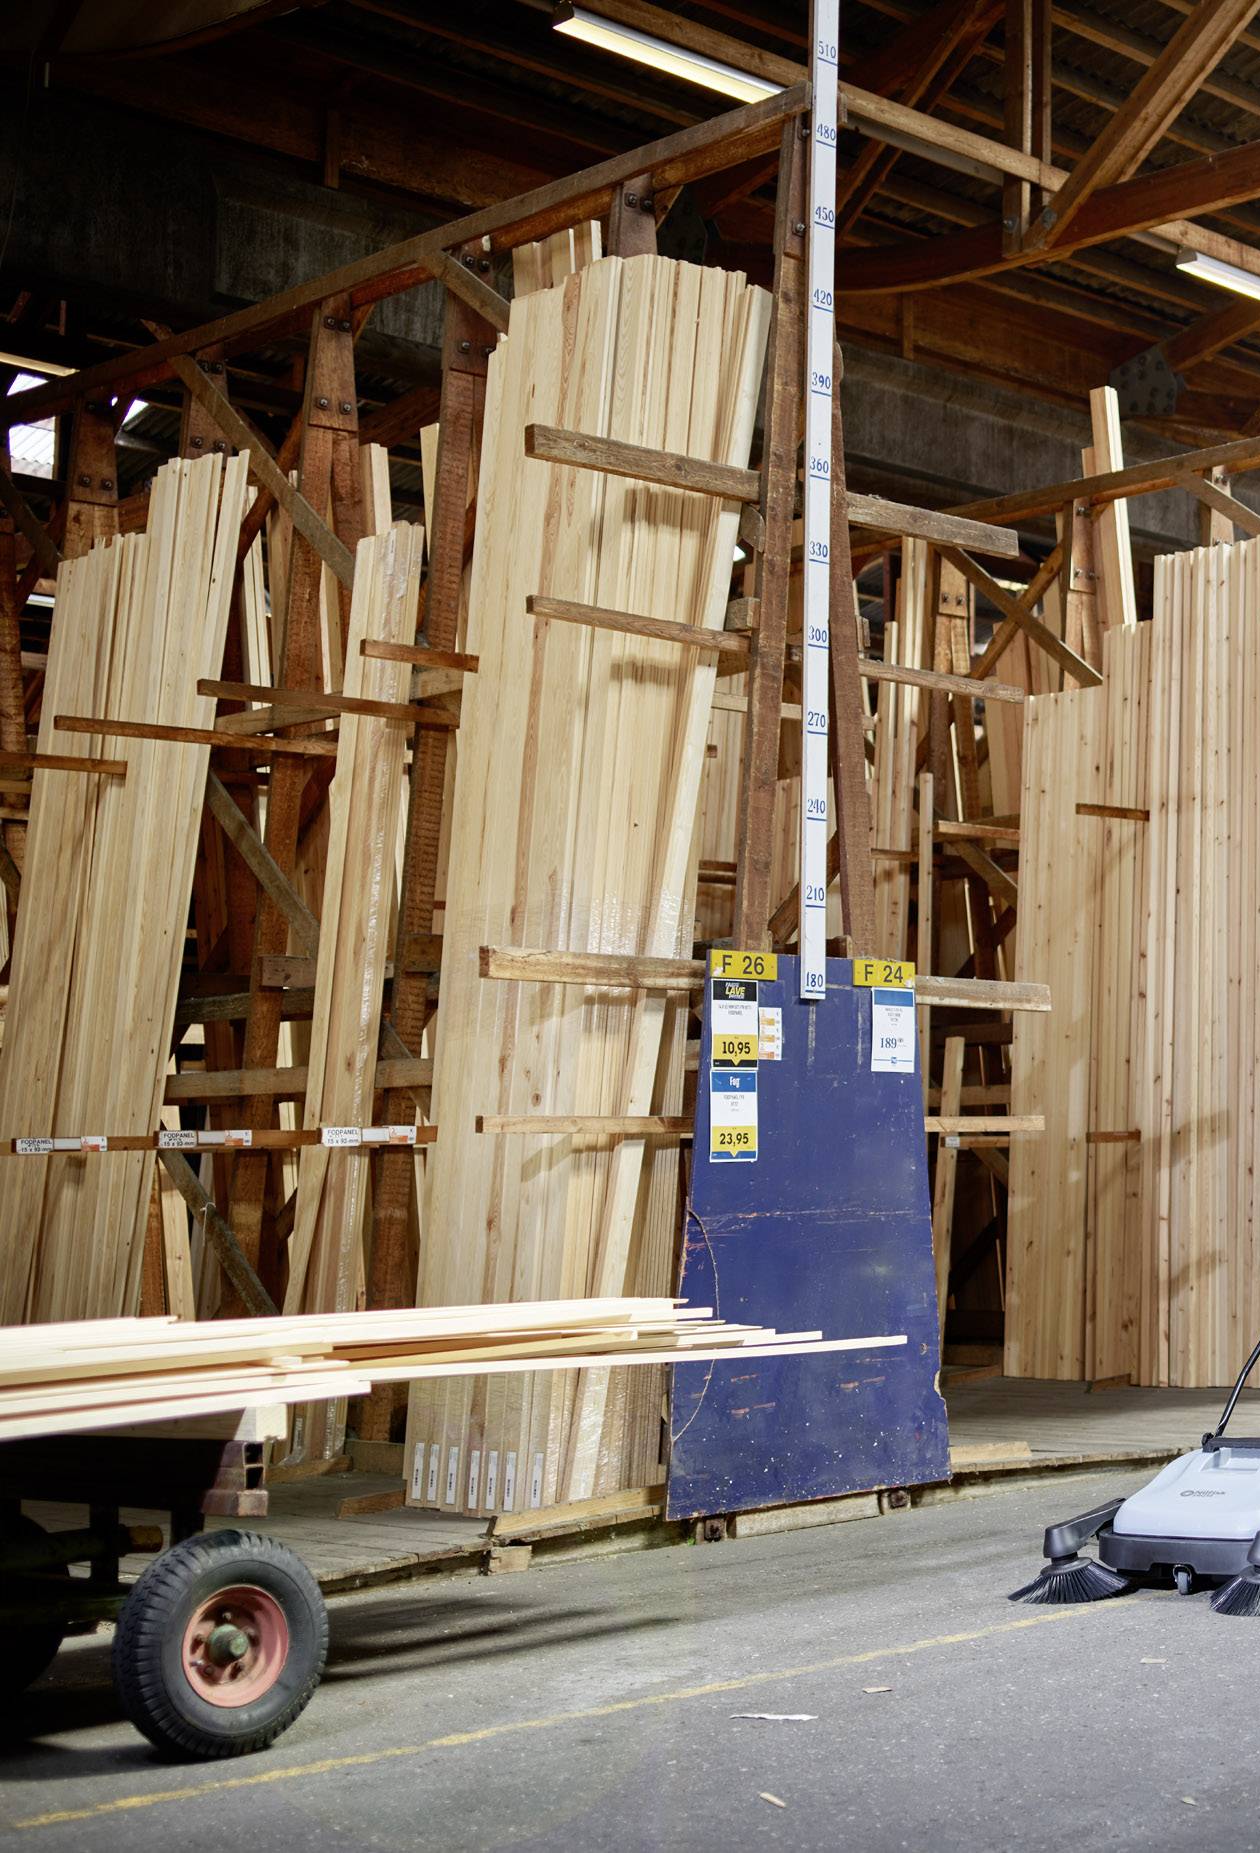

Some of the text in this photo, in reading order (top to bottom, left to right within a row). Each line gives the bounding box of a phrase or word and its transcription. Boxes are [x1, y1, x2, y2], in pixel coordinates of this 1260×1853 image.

[818, 41, 837, 59] 510
[817, 123, 836, 141] 480
[815, 206, 835, 223] 450
[813, 289, 833, 306] 420
[811, 371, 831, 389] 390
[810, 456, 829, 474] 360
[809, 541, 828, 559] 330
[808, 625, 828, 643] 300
[807, 711, 826, 728] 270
[807, 798, 826, 815] 240
[806, 886, 825, 902] 210
[722, 955, 765, 975] F 26
[806, 971, 824, 988] 180
[864, 964, 903, 984] F 24
[725, 986, 746, 995] LAVE
[722, 1041, 751, 1057] 10,95
[880, 1037, 897, 1050] 189
[719, 1132, 749, 1148] 23,95
